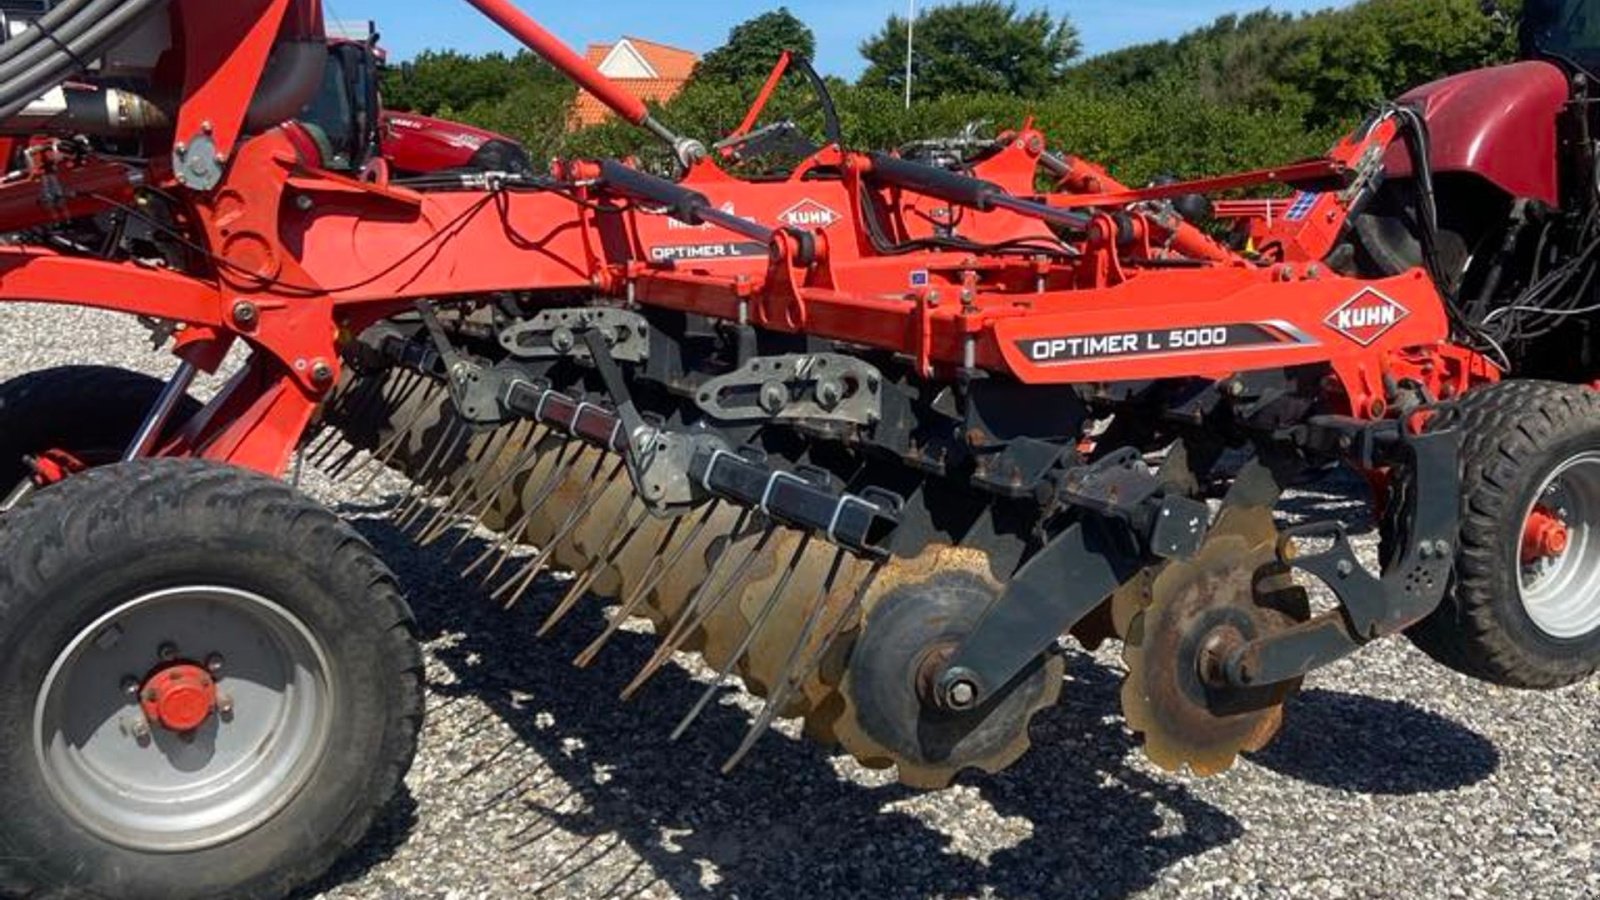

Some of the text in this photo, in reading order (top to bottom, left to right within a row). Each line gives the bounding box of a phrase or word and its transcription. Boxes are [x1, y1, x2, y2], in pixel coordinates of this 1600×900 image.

[788, 211, 832, 224] KUHN
[652, 244, 741, 259] OPTIMER L
[1337, 305, 1395, 330] KUHN
[1032, 327, 1226, 360] OPTIMER L 5000
